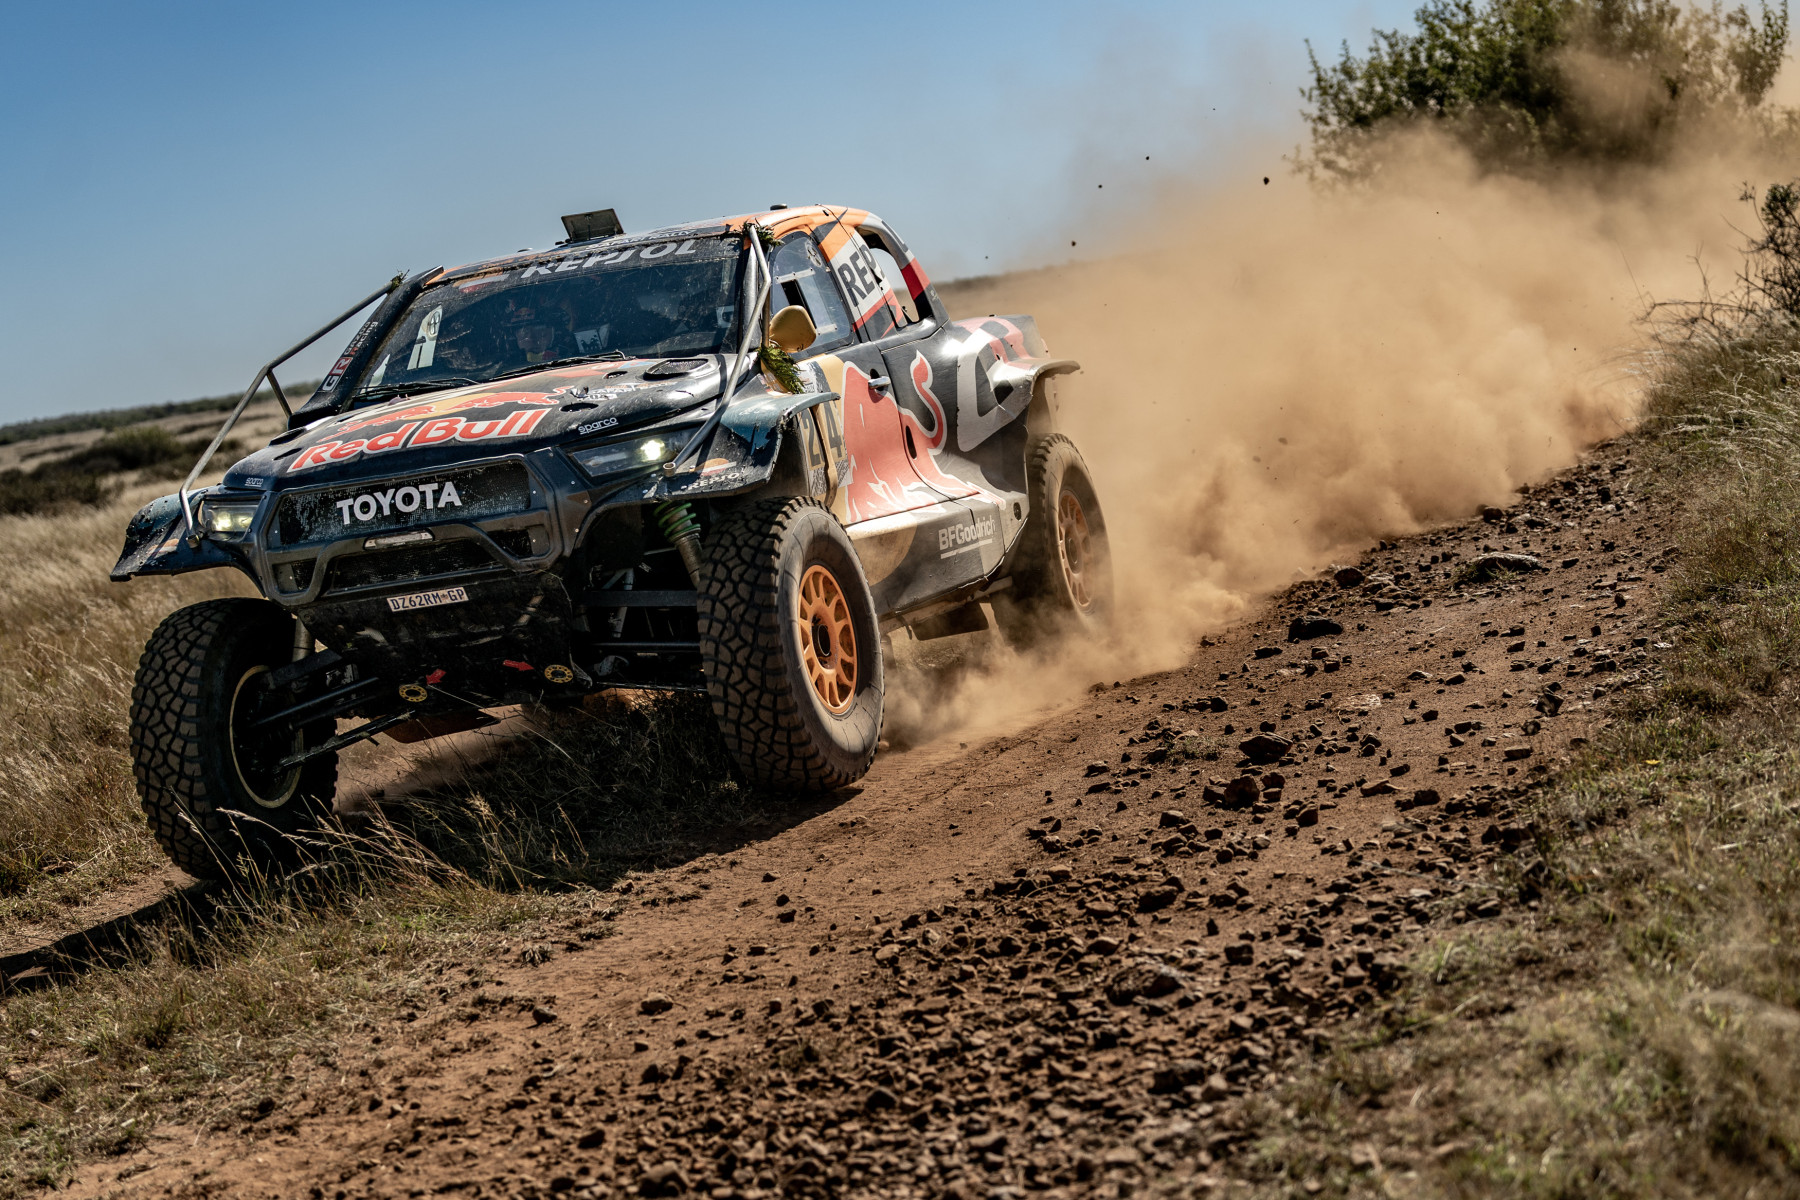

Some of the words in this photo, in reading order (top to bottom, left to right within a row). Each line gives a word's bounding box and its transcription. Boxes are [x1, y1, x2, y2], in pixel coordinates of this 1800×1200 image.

[838, 244, 885, 308] REP
[322, 357, 353, 391] GR
[287, 421, 418, 473] Red
[407, 408, 552, 447] Bull
[578, 417, 618, 435] sparco
[687, 470, 743, 491] REPSO
[336, 481, 462, 525] TOYOTA
[939, 514, 995, 551] BFGoodrich
[390, 592, 442, 610] DZ62RM
[447, 588, 465, 602] GP
